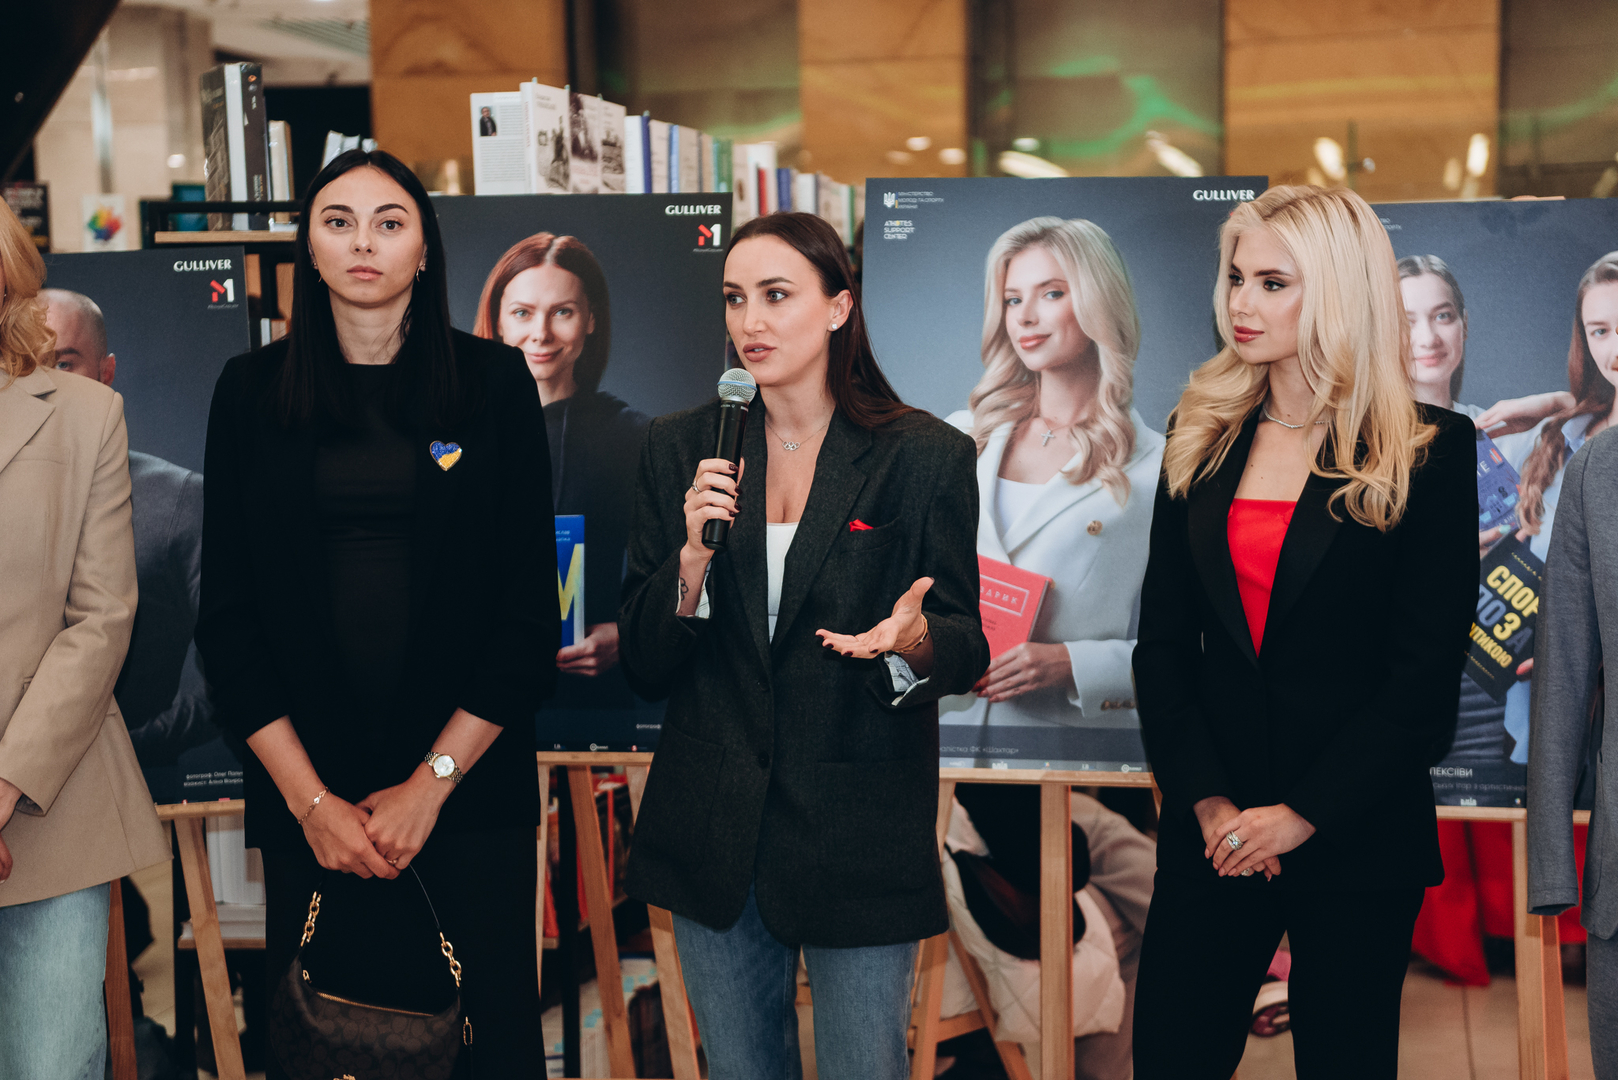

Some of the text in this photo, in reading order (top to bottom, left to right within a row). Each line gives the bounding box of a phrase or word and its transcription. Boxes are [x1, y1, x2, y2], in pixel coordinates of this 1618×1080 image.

[1193, 189, 1255, 201] GULLIVER
[665, 204, 722, 215] GULLIVER
[173, 259, 232, 273] GULLIVER
[1486, 565, 1540, 618] СПОР
[1469, 621, 1514, 669] ІТИКОЮ
[1429, 766, 1473, 778] ЛЕКСІЇВИ
